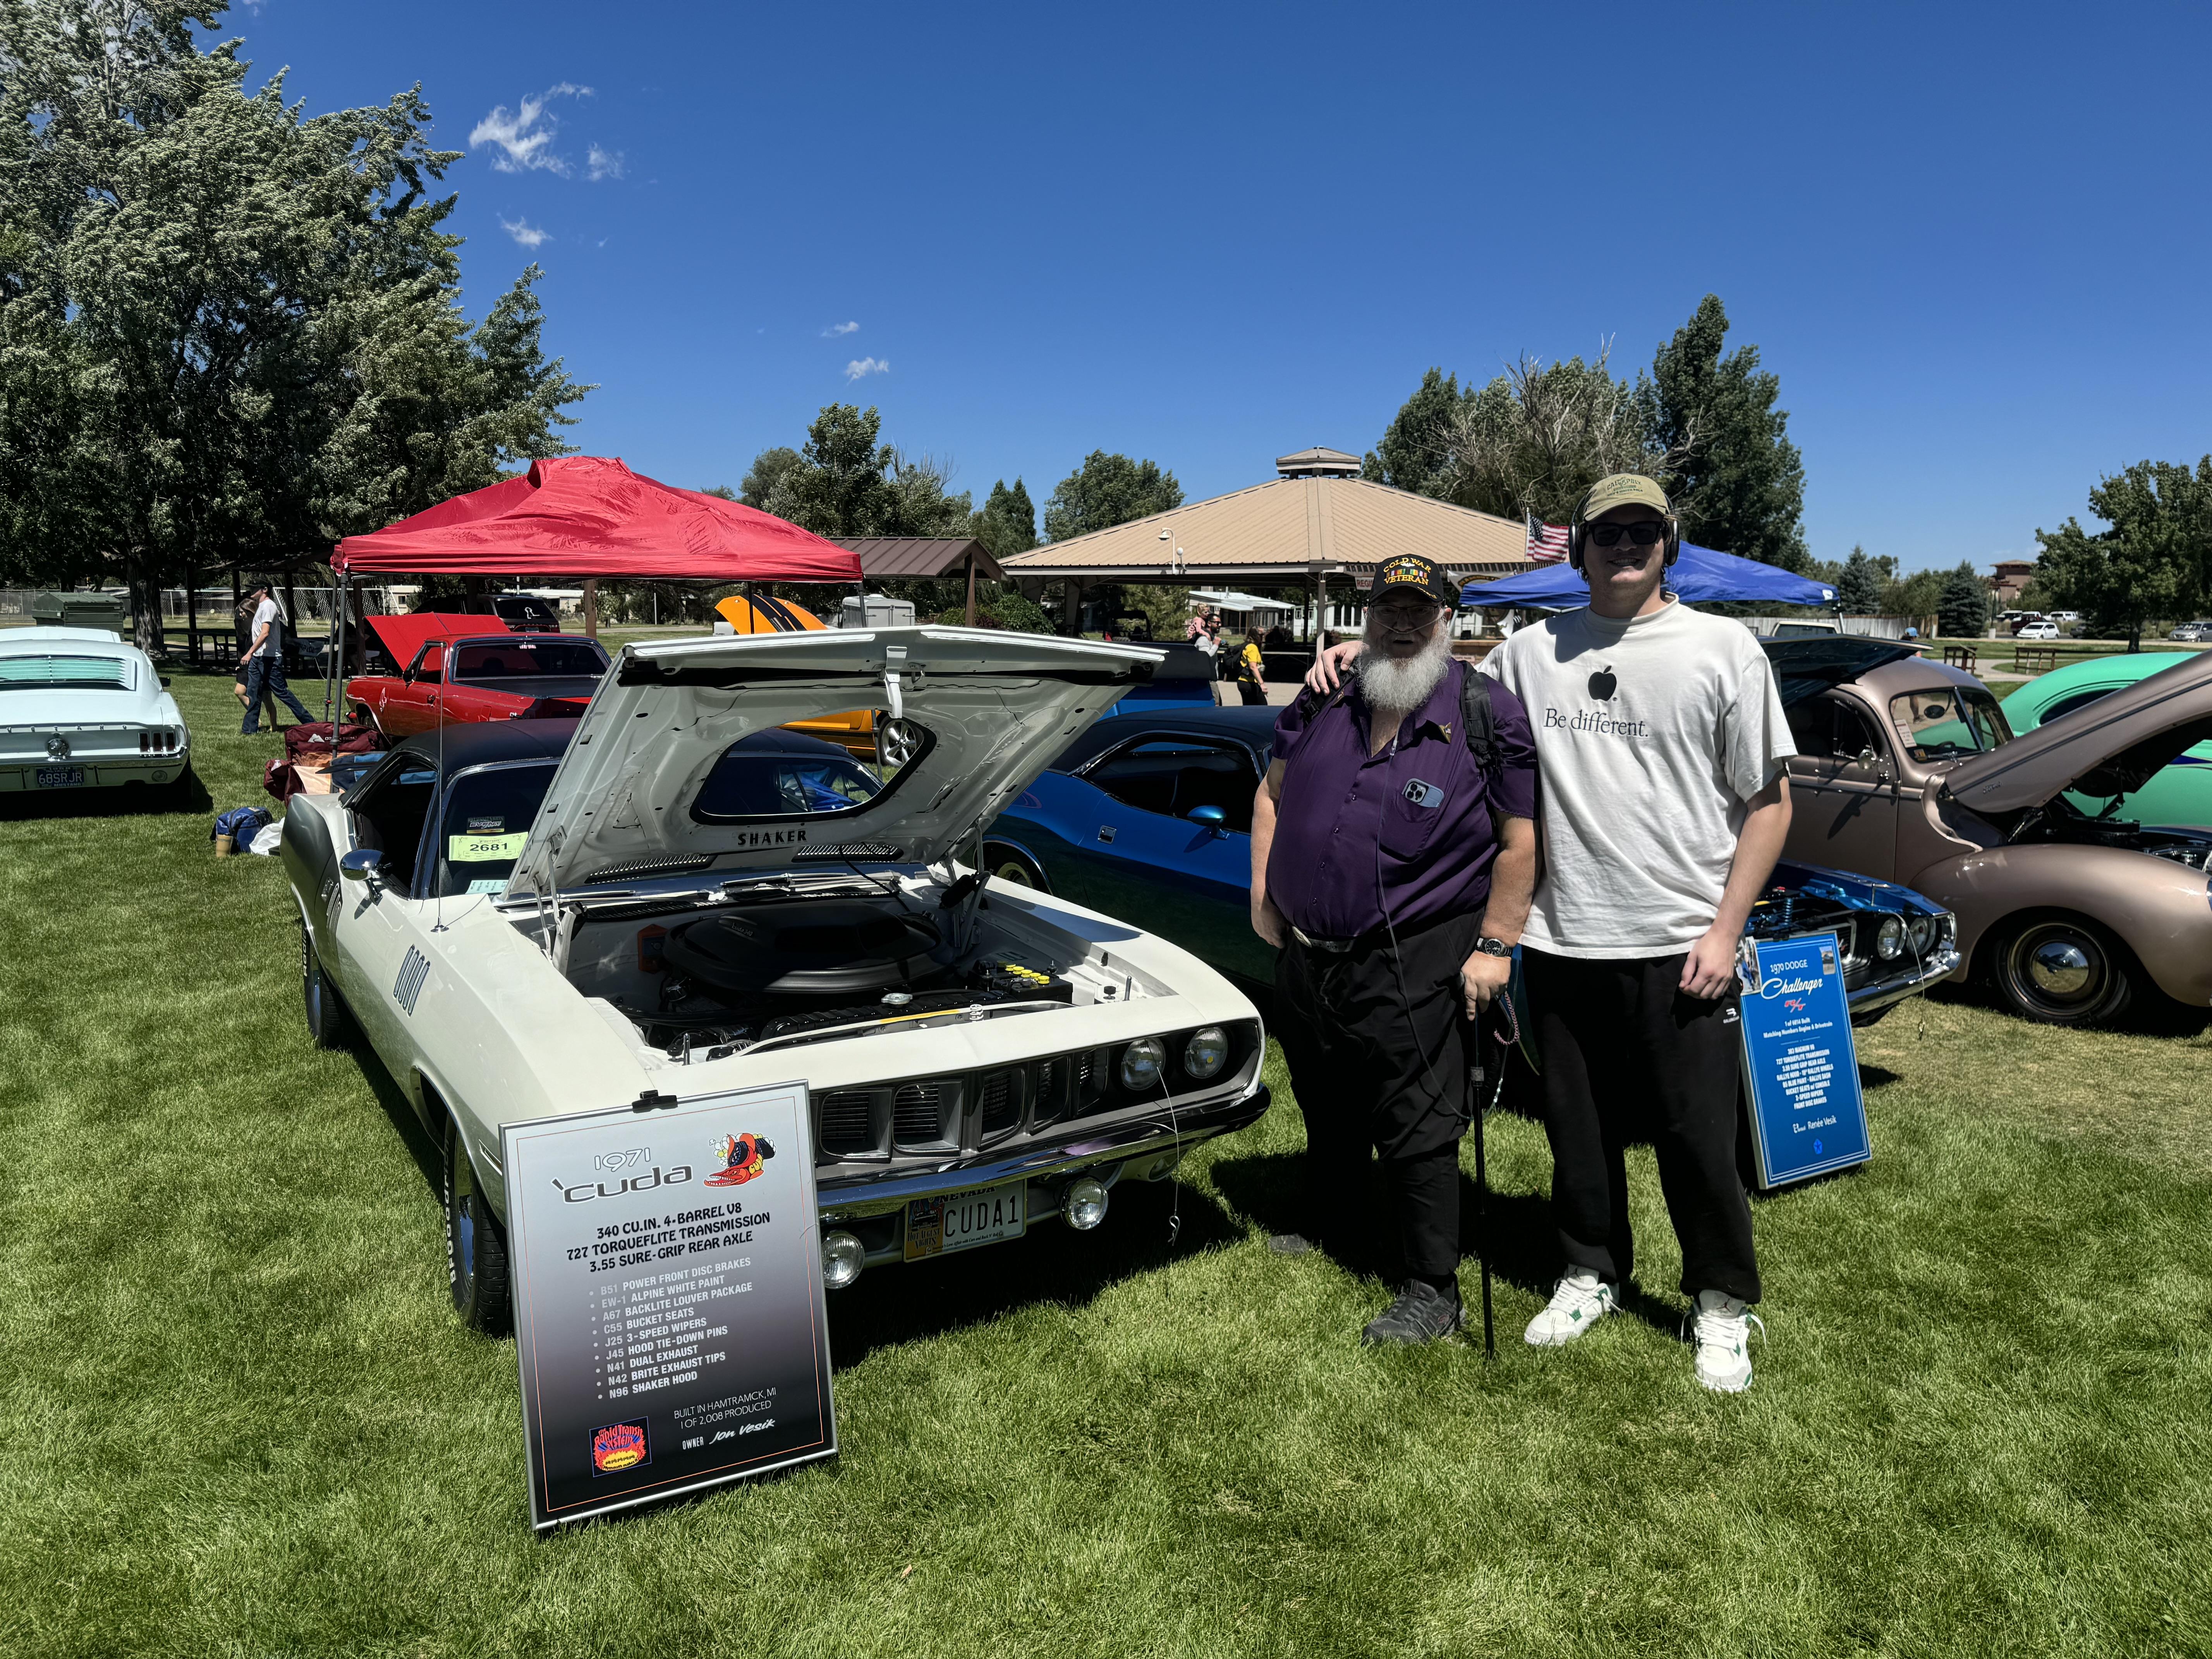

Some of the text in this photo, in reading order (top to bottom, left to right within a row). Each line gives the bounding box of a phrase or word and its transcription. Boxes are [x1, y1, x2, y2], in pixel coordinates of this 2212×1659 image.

[1383, 557, 1432, 573] COLD WAR
[1384, 575, 1429, 586] VETERAN
[1543, 708, 1649, 737] Be different.
[470, 843, 507, 851] 2681
[738, 830, 807, 845] SHAKER
[1770, 959, 1808, 974] 1970 DODGE
[1760, 977, 1823, 1000] Challenger
[594, 1147, 651, 1172] 1971
[444, 1138, 457, 1283] BFGoodrich
[597, 1202, 742, 1239] 340 CU.IN. 4-BARREL V8
[945, 1195, 1018, 1238] CUDA1
[567, 1212, 769, 1260] 727 TORQUEFLITE TRANSMISSION
[907, 1232, 919, 1242] HOT
[915, 1237, 936, 1250] NIGHTS
[590, 1230, 752, 1272] 3.55 SURE-GRIP REAR AXLE
[601, 1257, 750, 1295] B51 POWER FRONT DISC BRAKES
[602, 1275, 724, 1308] EW-1 ALPINE WHITE PAINT
[603, 1282, 752, 1321] A67 BACKLITE LOUVER PACKAGE
[604, 1307, 694, 1333] C55 BUCKET SEATS
[605, 1317, 706, 1346] J25 3-SPEED WIPERS
[606, 1326, 728, 1359] J45 HOOD TIE-DOWN PINS
[607, 1345, 698, 1372] N41 DUAL EXHAUST
[608, 1352, 725, 1385] N42 BRITE EXHAUST TIPS
[609, 1371, 697, 1398] N96 SHAKER HOOD
[674, 1406, 694, 1419] BUILT
[697, 1404, 705, 1413] IN
[685, 1418, 697, 1427] OF
[699, 1412, 723, 1424] 2,008
[725, 1400, 771, 1418] PRODUCED
[594, 1424, 643, 1446] Rapid Transit
[682, 1419, 775, 1450] OWNER Jon Vesik
